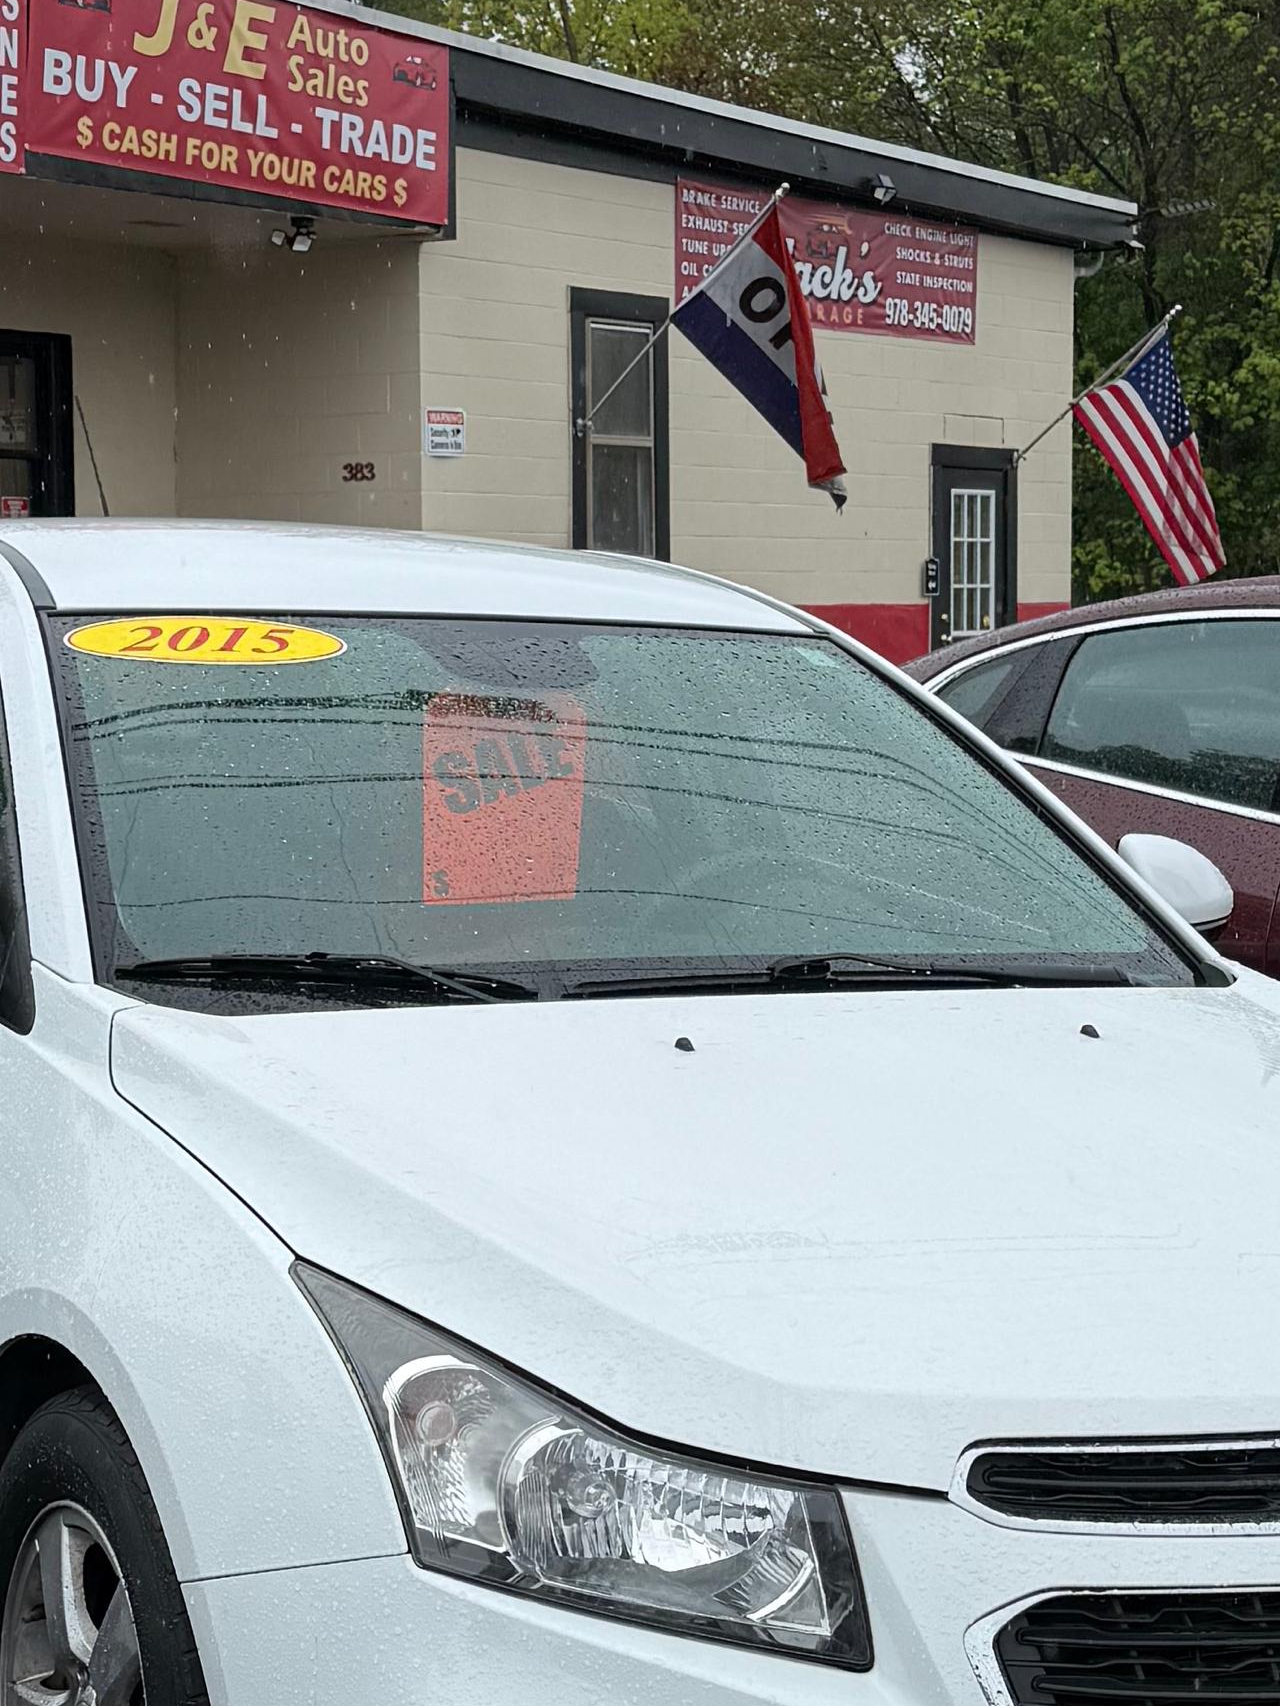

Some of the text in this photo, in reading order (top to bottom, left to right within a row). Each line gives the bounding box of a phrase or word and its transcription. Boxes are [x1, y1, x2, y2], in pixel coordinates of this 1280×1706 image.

[286, 14, 370, 67] Auto
[287, 55, 370, 107] Sales
[42, 47, 138, 109] BUY
[176, 77, 279, 139] SELL
[315, 107, 437, 171] TRADE
[75, 115, 408, 208] $ CASH FOR YOUR CARS $
[682, 188, 760, 214] BRAKE SERVICE
[681, 214, 728, 233] EXHAUST
[884, 222, 974, 248] CHECK ENGINE LIGHT
[681, 238, 708, 254] TUNE
[895, 246, 974, 270] SHOCKS & STRUTS
[680, 261, 698, 277] OIL
[786, 237, 883, 304] ack's
[895, 271, 973, 293] STATE INSPECTION
[884, 297, 972, 334] 978-345-0079
[342, 461, 376, 482] 383
[119, 625, 296, 655] 2015
[432, 723, 575, 814] SALE
